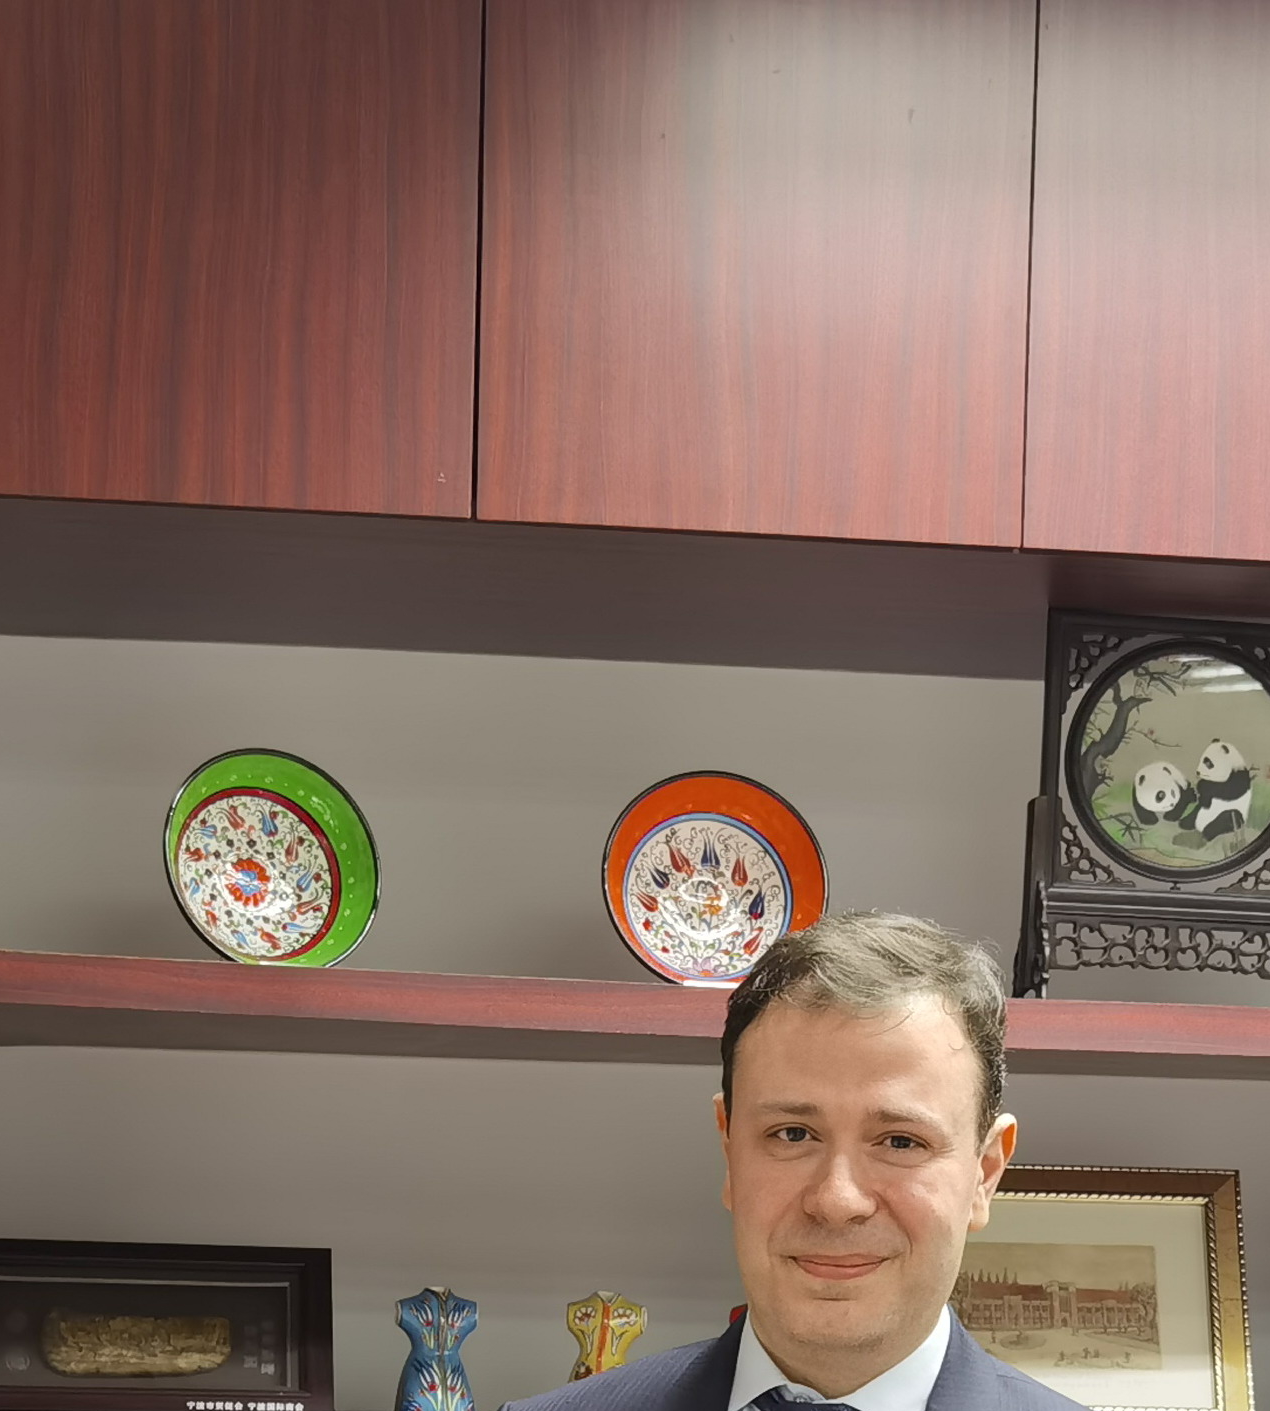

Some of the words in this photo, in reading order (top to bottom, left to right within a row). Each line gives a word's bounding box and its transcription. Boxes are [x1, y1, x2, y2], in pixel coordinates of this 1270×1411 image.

[247, 1402, 304, 1411] 宁波国际商会
